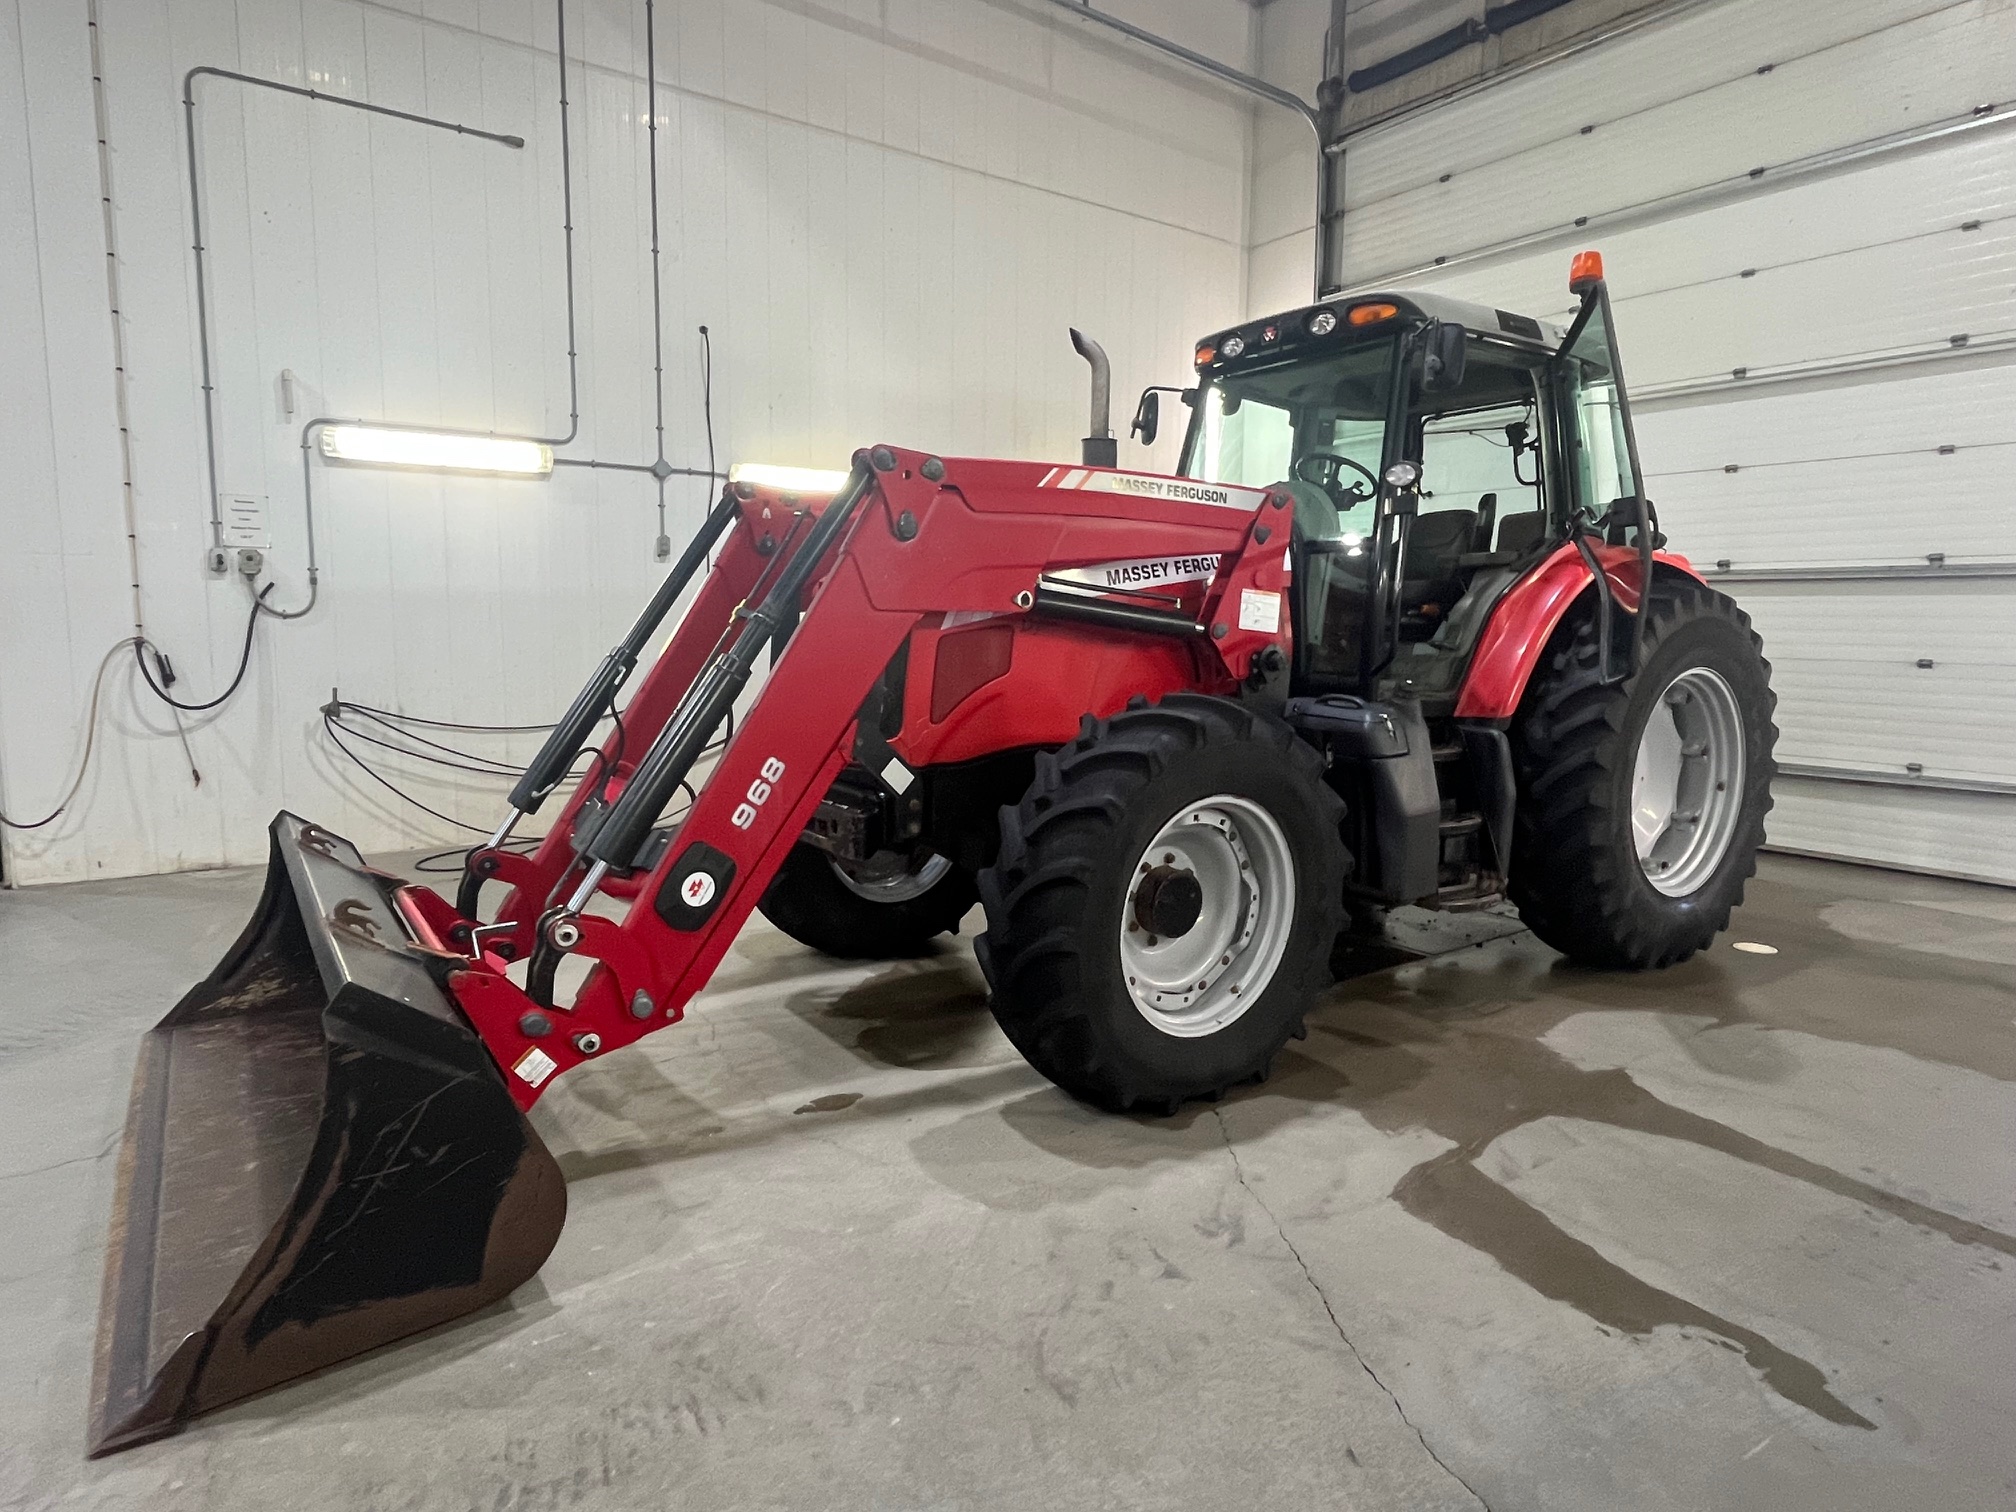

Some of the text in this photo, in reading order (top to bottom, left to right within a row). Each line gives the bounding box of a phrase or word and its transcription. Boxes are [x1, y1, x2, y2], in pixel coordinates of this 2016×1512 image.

[1112, 477, 1227, 503] MASSEY FERGUSON
[1106, 562, 1168, 585] MASSEY
[731, 757, 785, 829] 968
